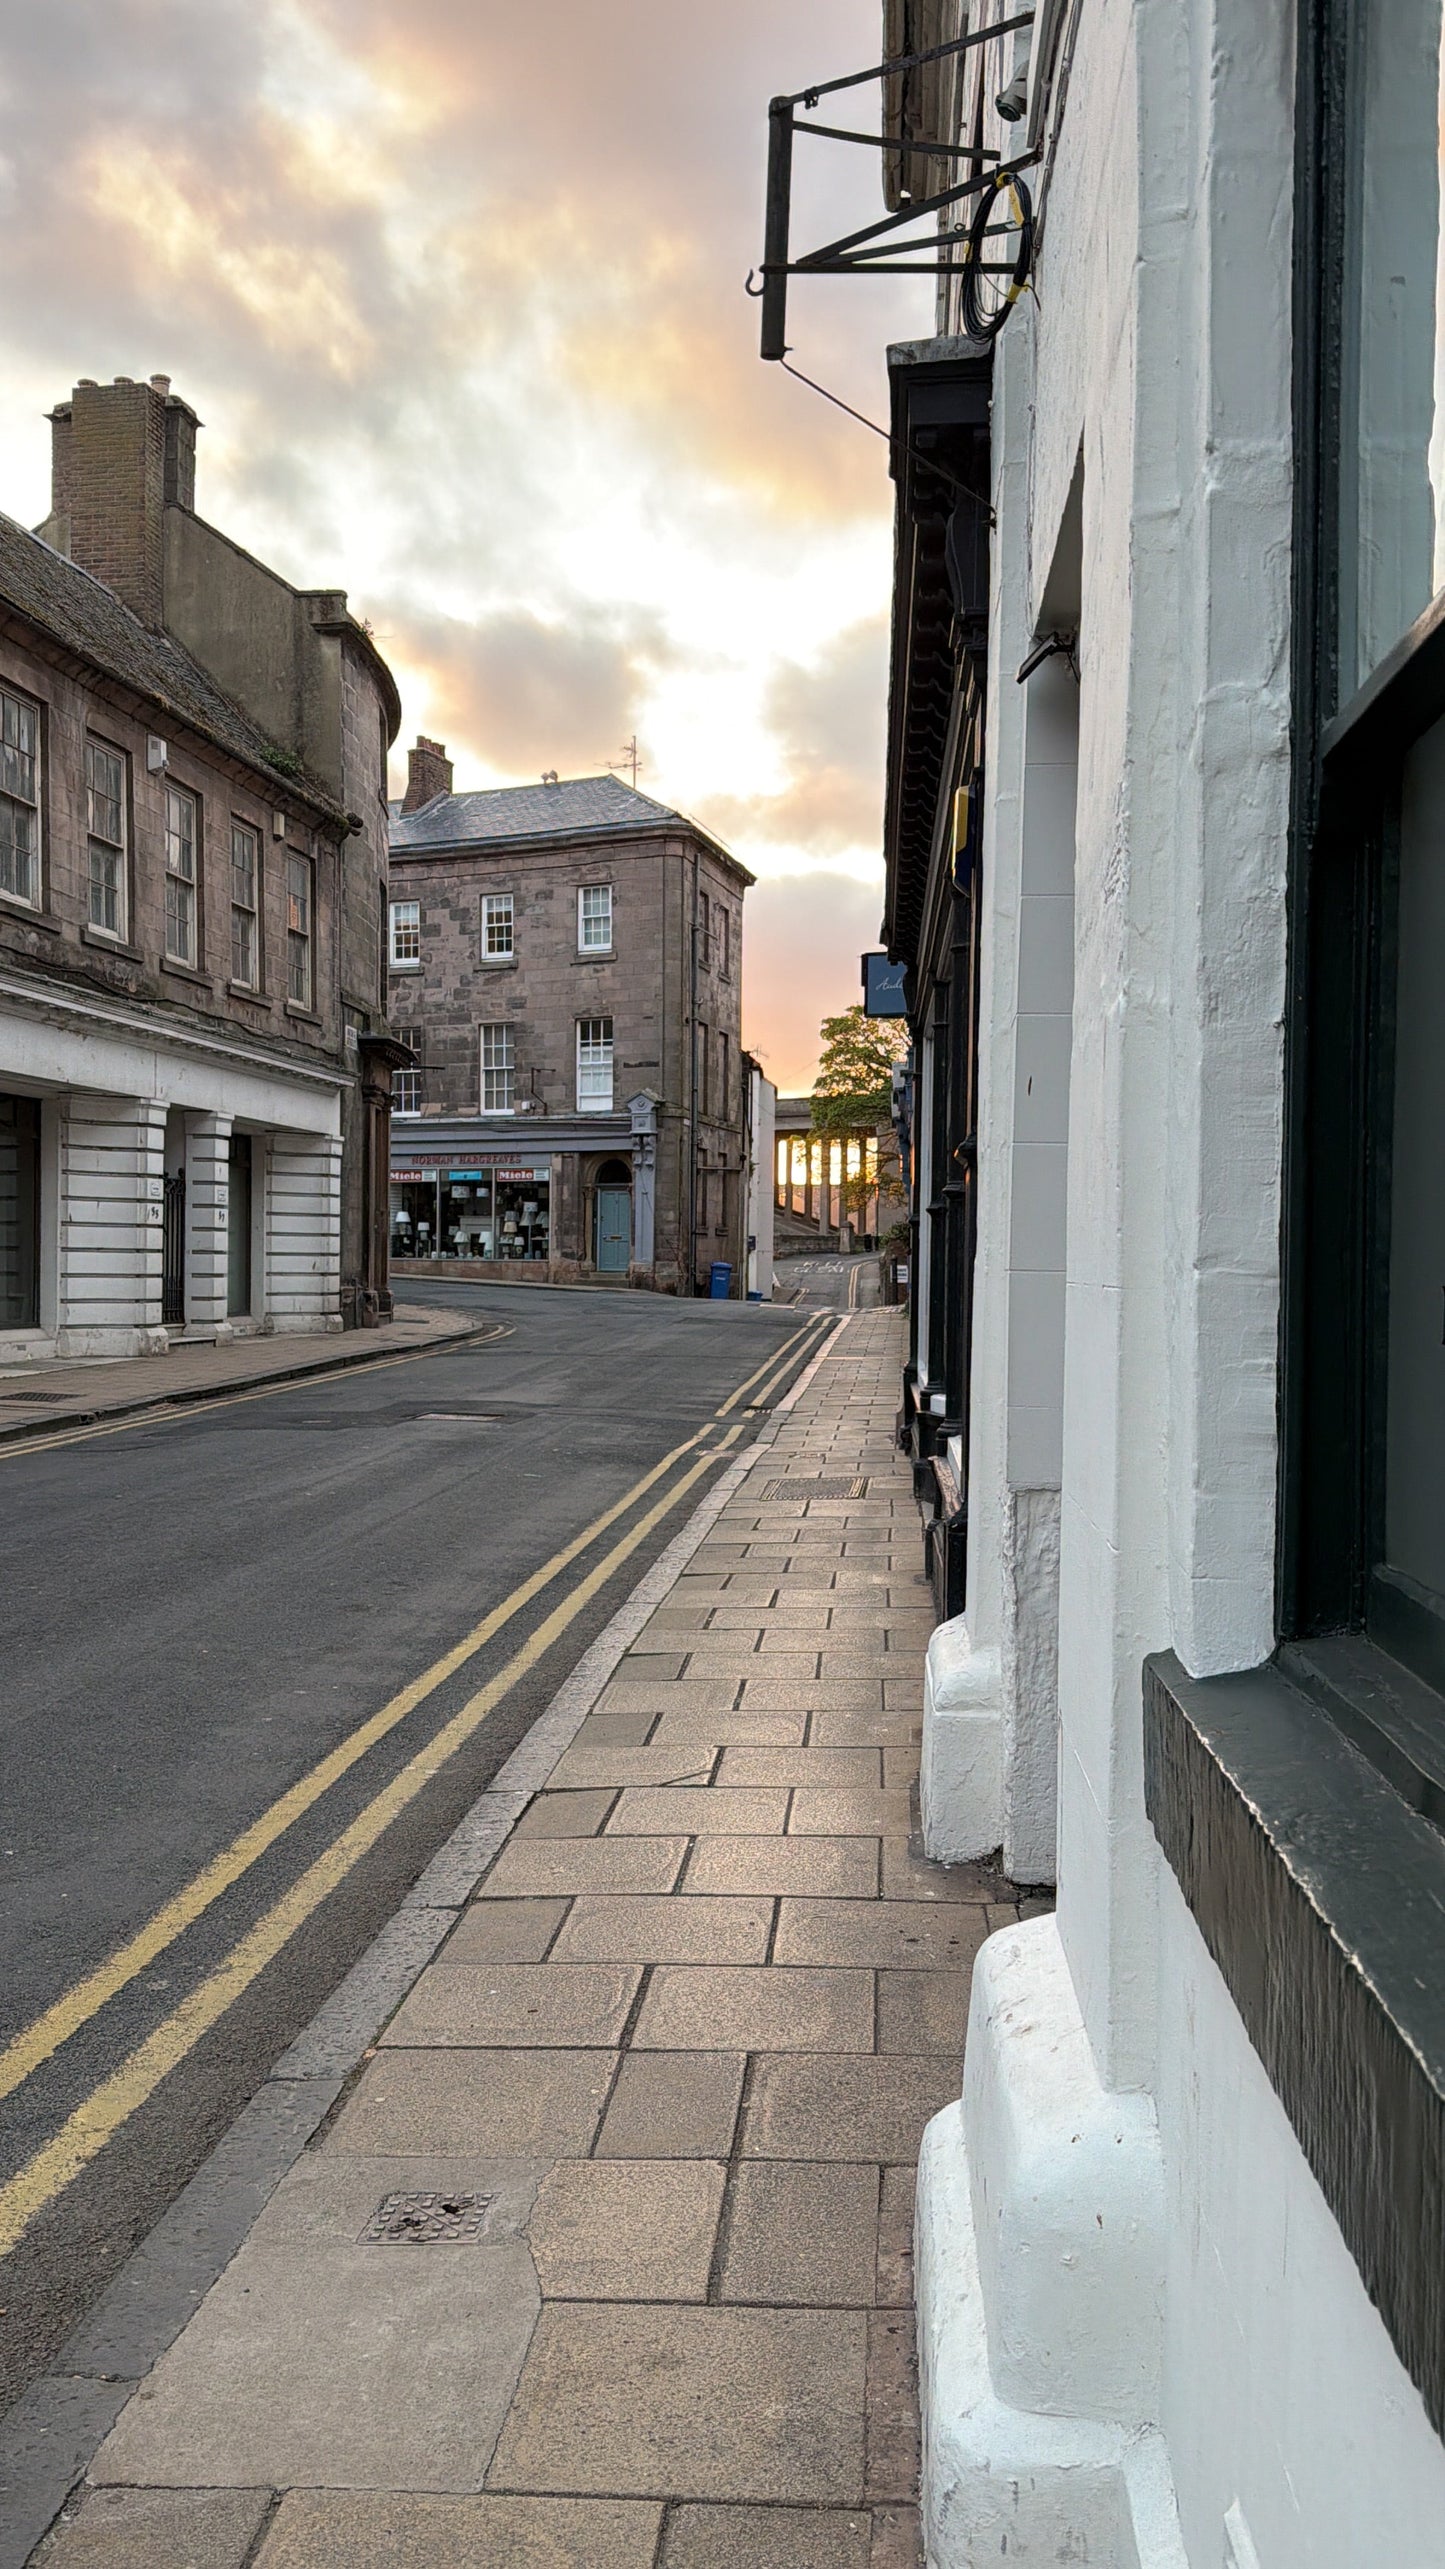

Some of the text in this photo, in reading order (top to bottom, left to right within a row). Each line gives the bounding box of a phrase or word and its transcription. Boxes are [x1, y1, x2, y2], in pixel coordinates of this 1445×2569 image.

[411, 1154, 522, 1166] NORMAN HARGREAVES
[390, 1171, 421, 1181] Miele
[499, 1170, 533, 1179] Miele
